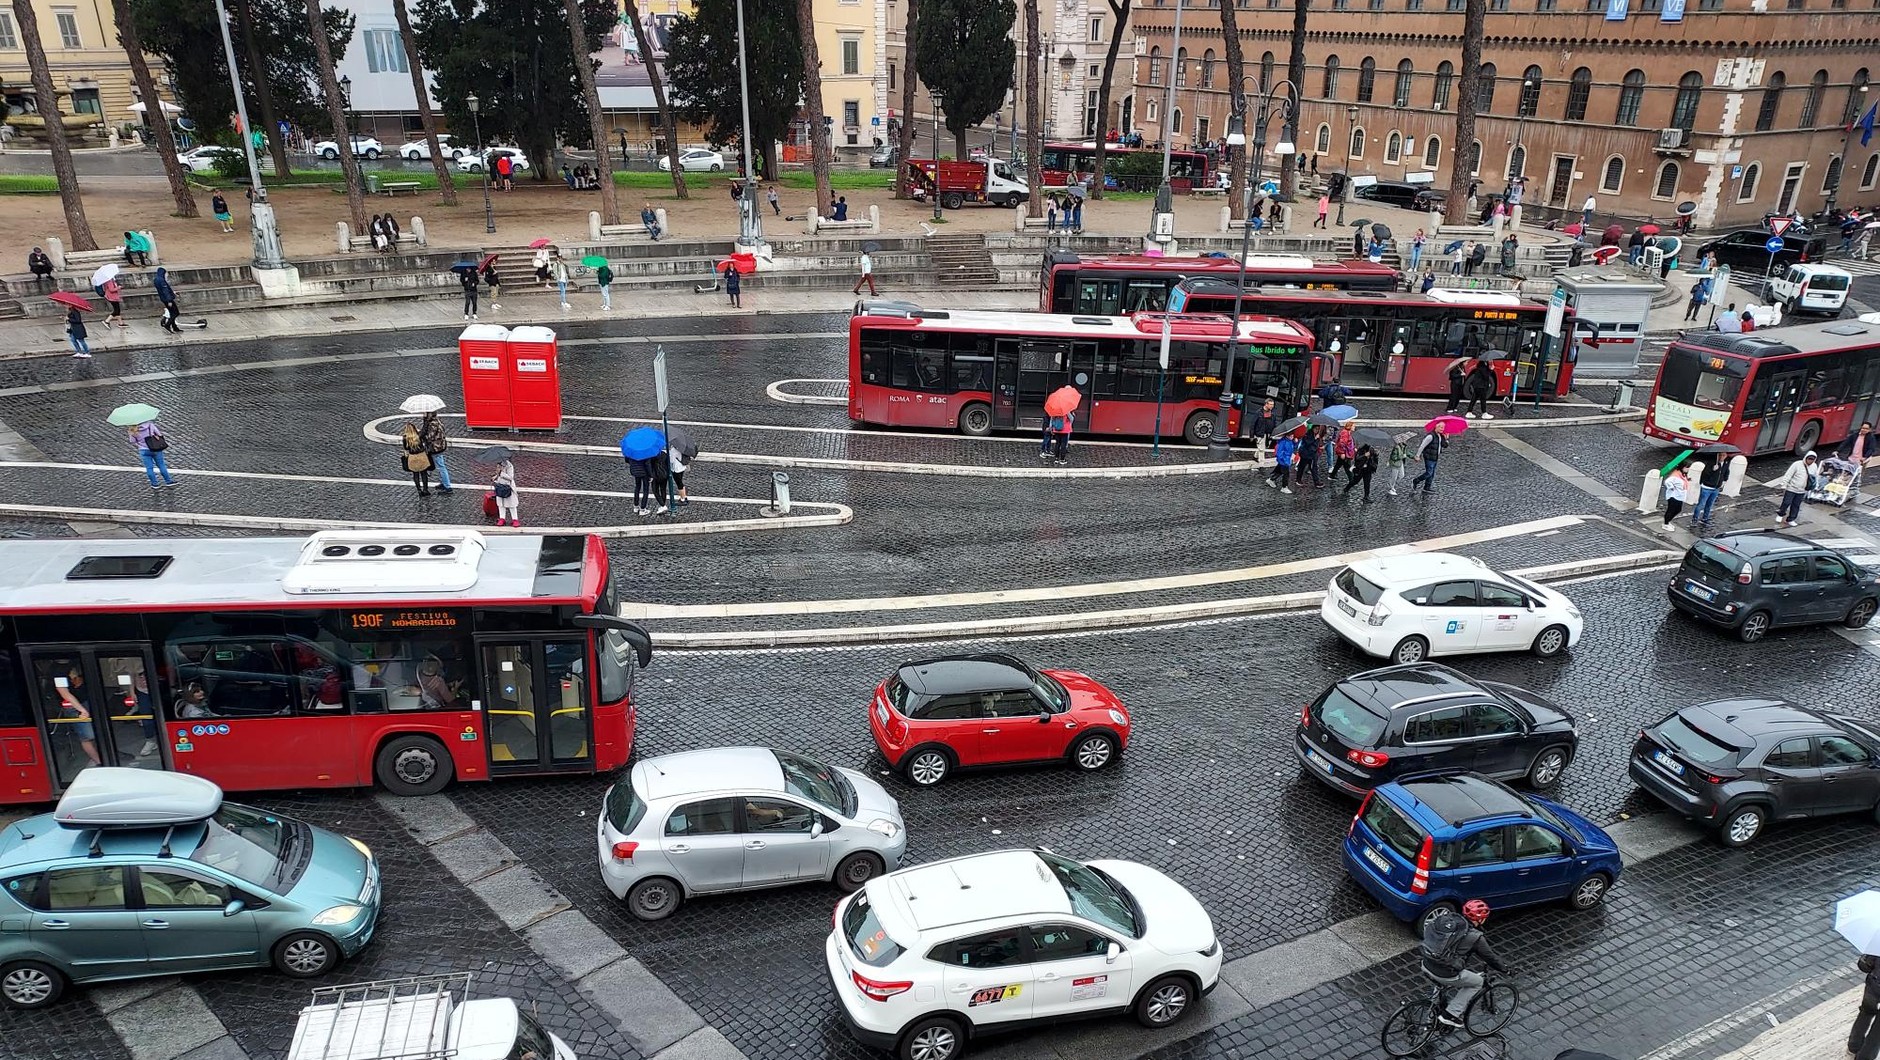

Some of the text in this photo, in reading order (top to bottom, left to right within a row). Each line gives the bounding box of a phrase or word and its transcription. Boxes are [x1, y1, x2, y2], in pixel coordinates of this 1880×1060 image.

[1250, 345, 1285, 354] Bus Ibrido
[1711, 357, 1725, 369] 781
[929, 396, 947, 404] atac
[351, 612, 449, 628] 190F FESTIVO
[975, 988, 1003, 1003] 6677
[1009, 987, 1017, 996] T
